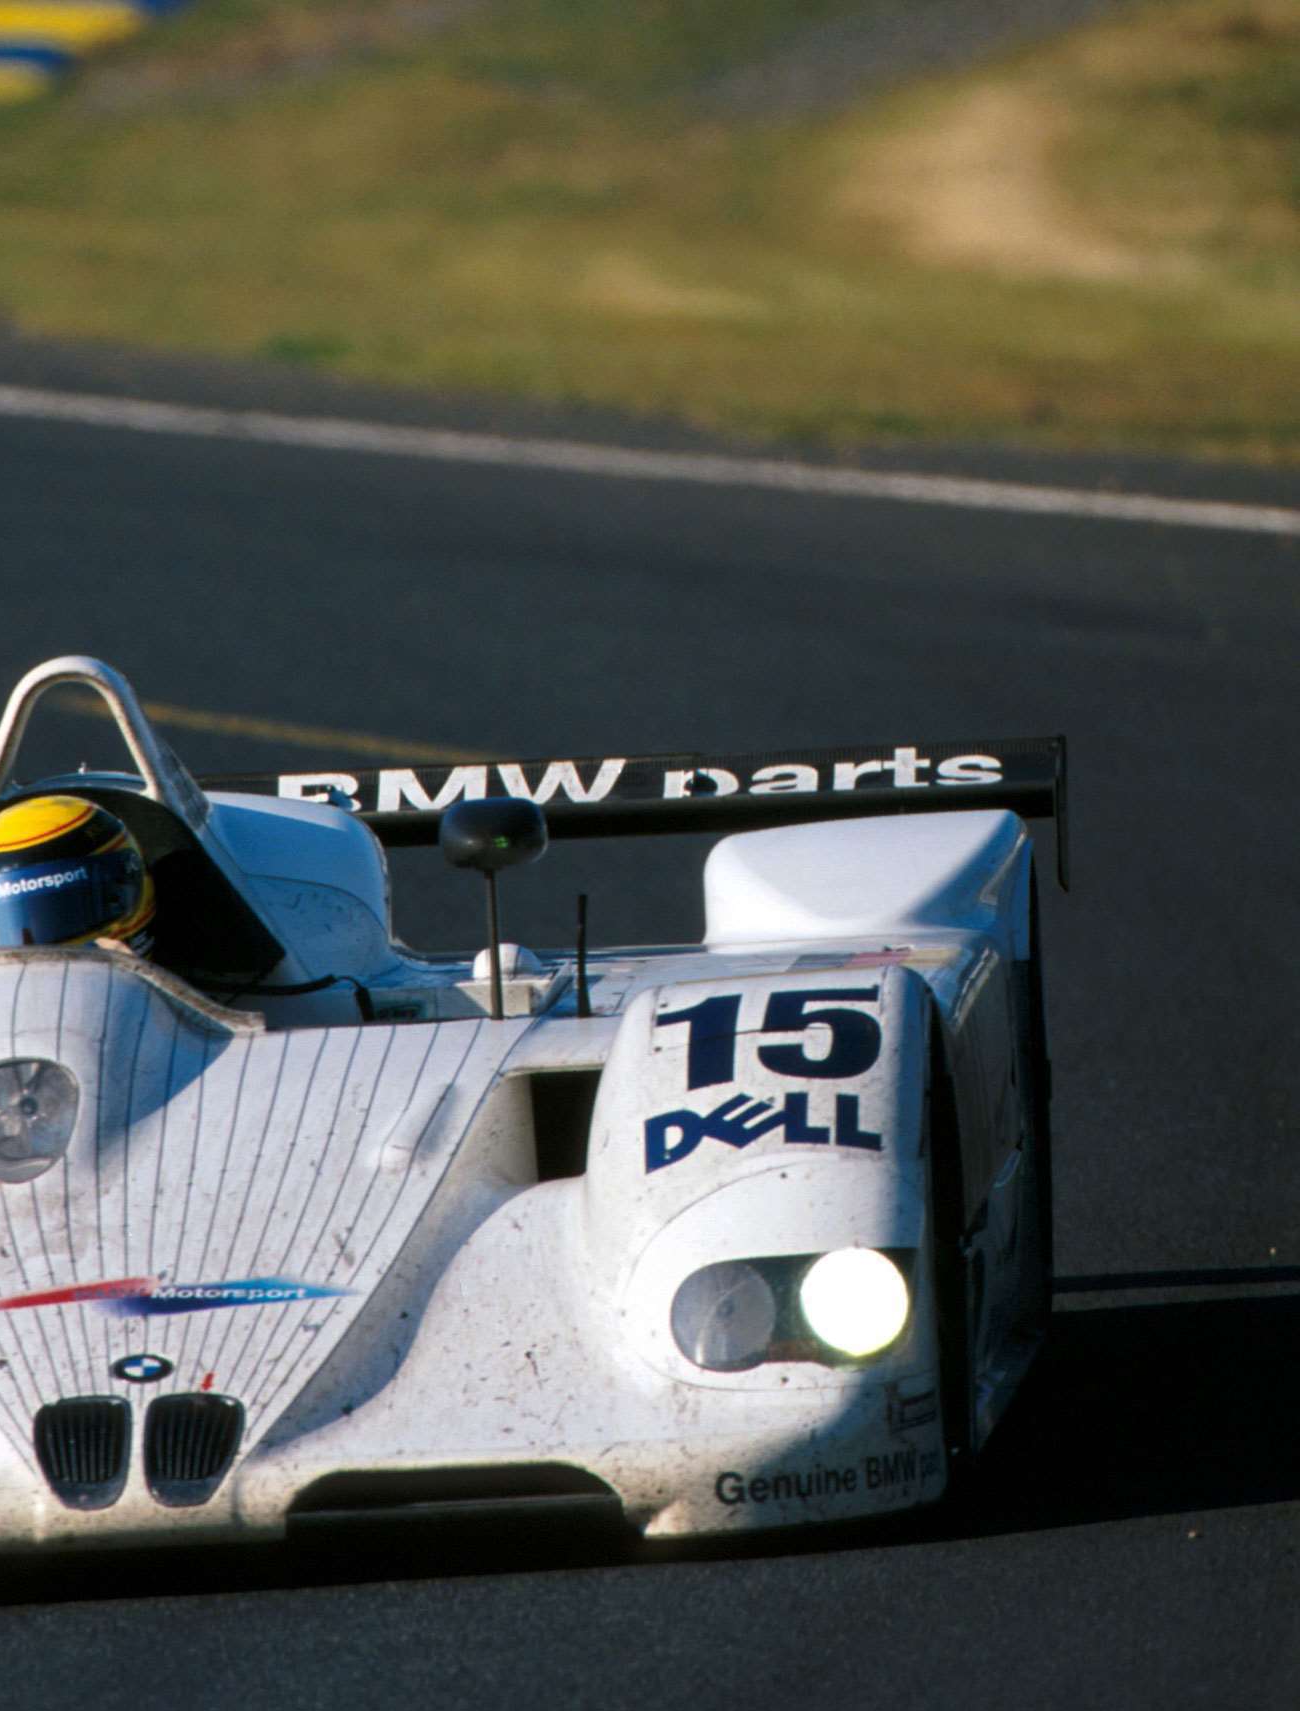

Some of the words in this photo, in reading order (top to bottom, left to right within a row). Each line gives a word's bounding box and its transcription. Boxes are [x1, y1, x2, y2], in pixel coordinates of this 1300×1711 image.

[277, 758, 627, 812] BMW
[662, 747, 1003, 798] parts
[656, 985, 882, 1092] 15
[644, 1091, 882, 1175] DELL
[151, 1287, 307, 1300] Motorsport
[714, 1463, 858, 1506] Genuine
[865, 1446, 917, 1490] BMW
